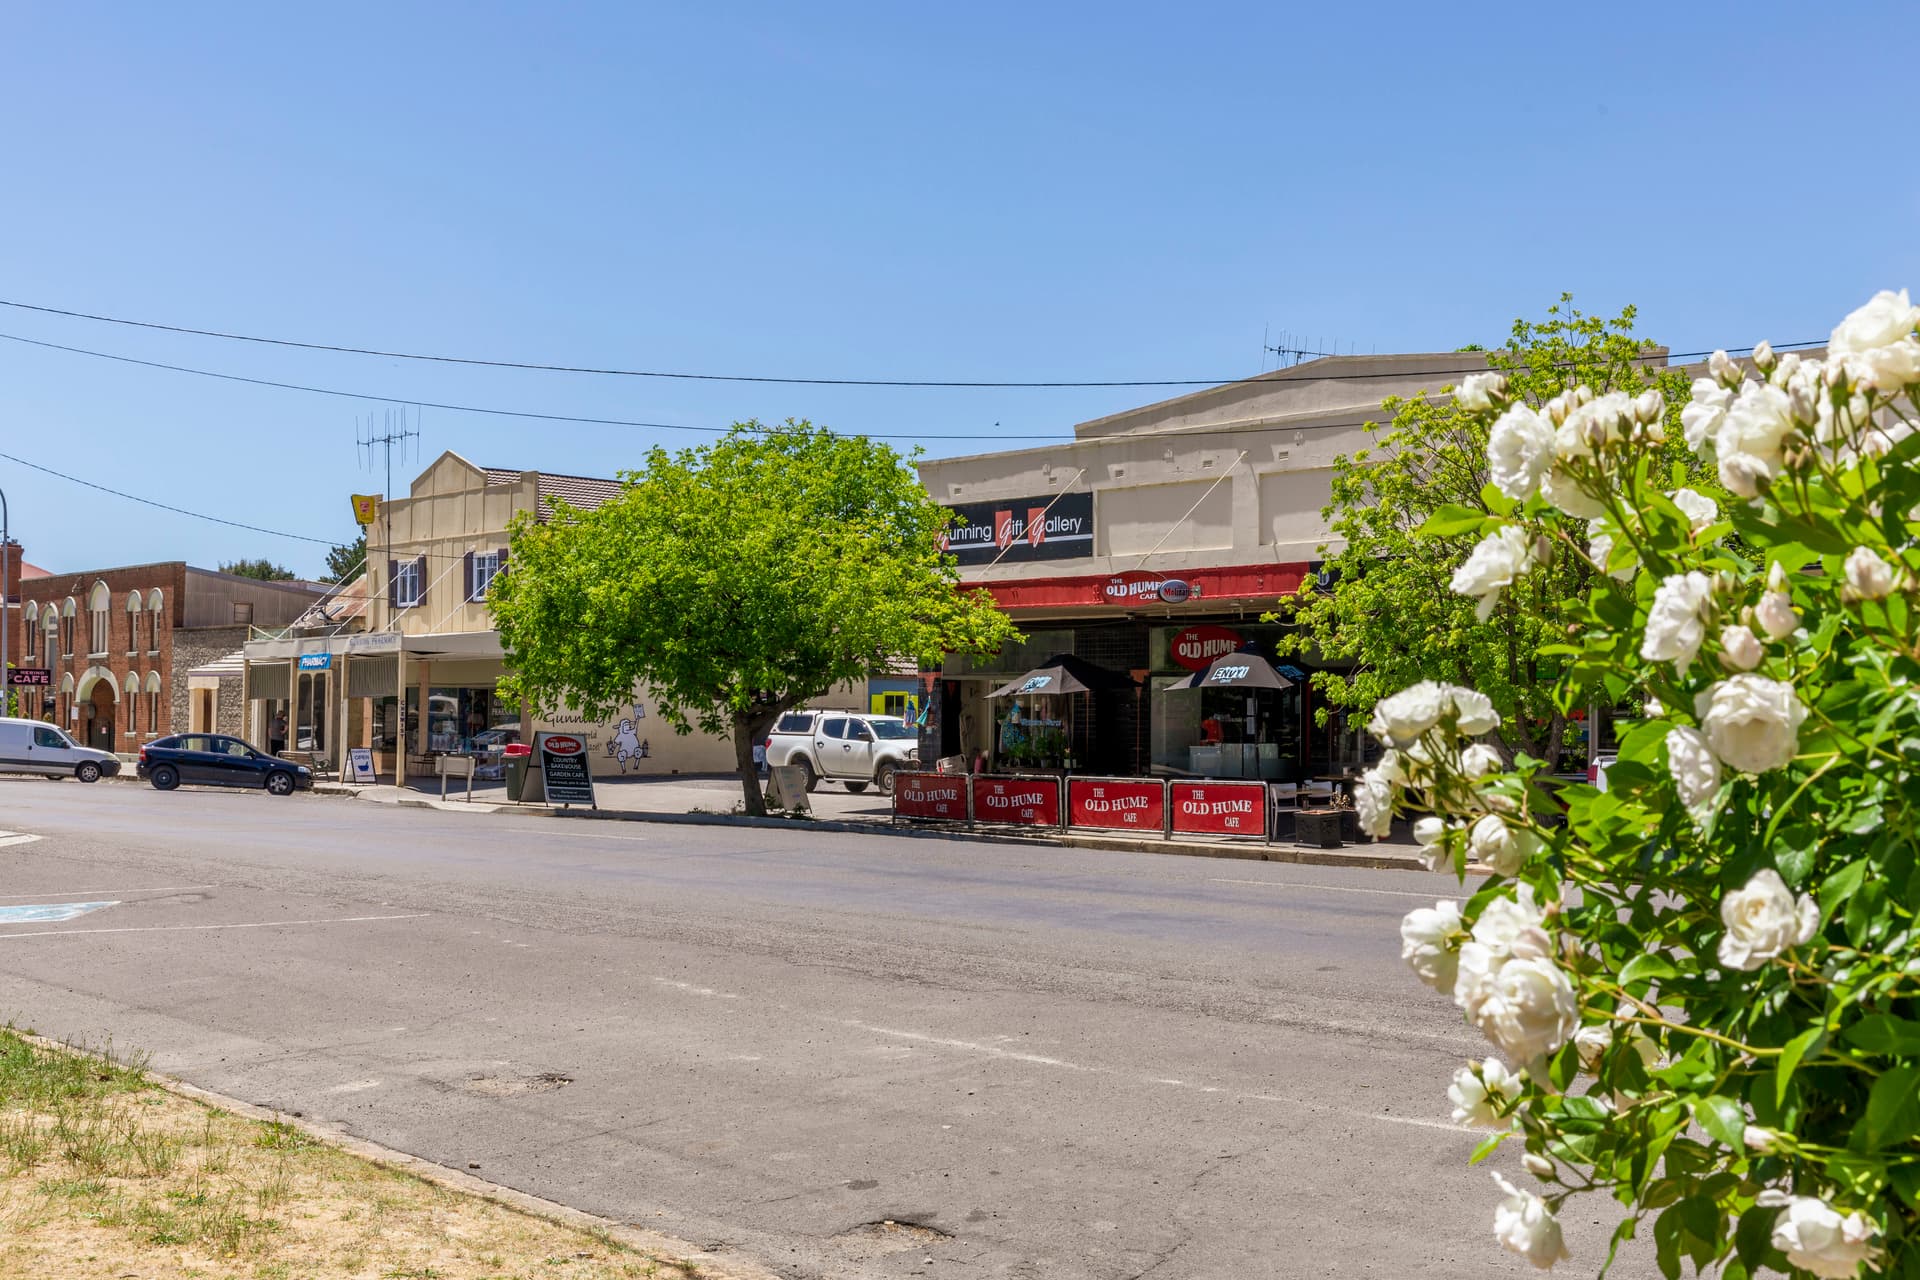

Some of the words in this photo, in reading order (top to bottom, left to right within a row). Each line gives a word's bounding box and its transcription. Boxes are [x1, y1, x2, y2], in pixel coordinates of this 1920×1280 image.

[1000, 518, 1023, 550] Gift
[1032, 514, 1083, 548] Gallery
[1106, 584, 1128, 597] OLD
[1178, 642, 1202, 659] OLD
[13, 675, 49, 683] CAFE
[547, 741, 560, 749] OLD
[904, 789, 924, 802] OLD
[927, 789, 957, 801] HUME
[994, 785, 1004, 795] THE
[1093, 788, 1105, 798] THE
[1192, 790, 1204, 800] THE
[986, 795, 1009, 808] OLD
[1011, 793, 1044, 807] HUME
[1085, 799, 1110, 812] OLD
[1112, 796, 1148, 811] HUME
[1021, 808, 1034, 818] CAFE
[1183, 801, 1210, 815] OLD
[1212, 800, 1252, 815] HUME
[1123, 812, 1137, 823] CAFE
[1225, 816, 1240, 828] CAFE
